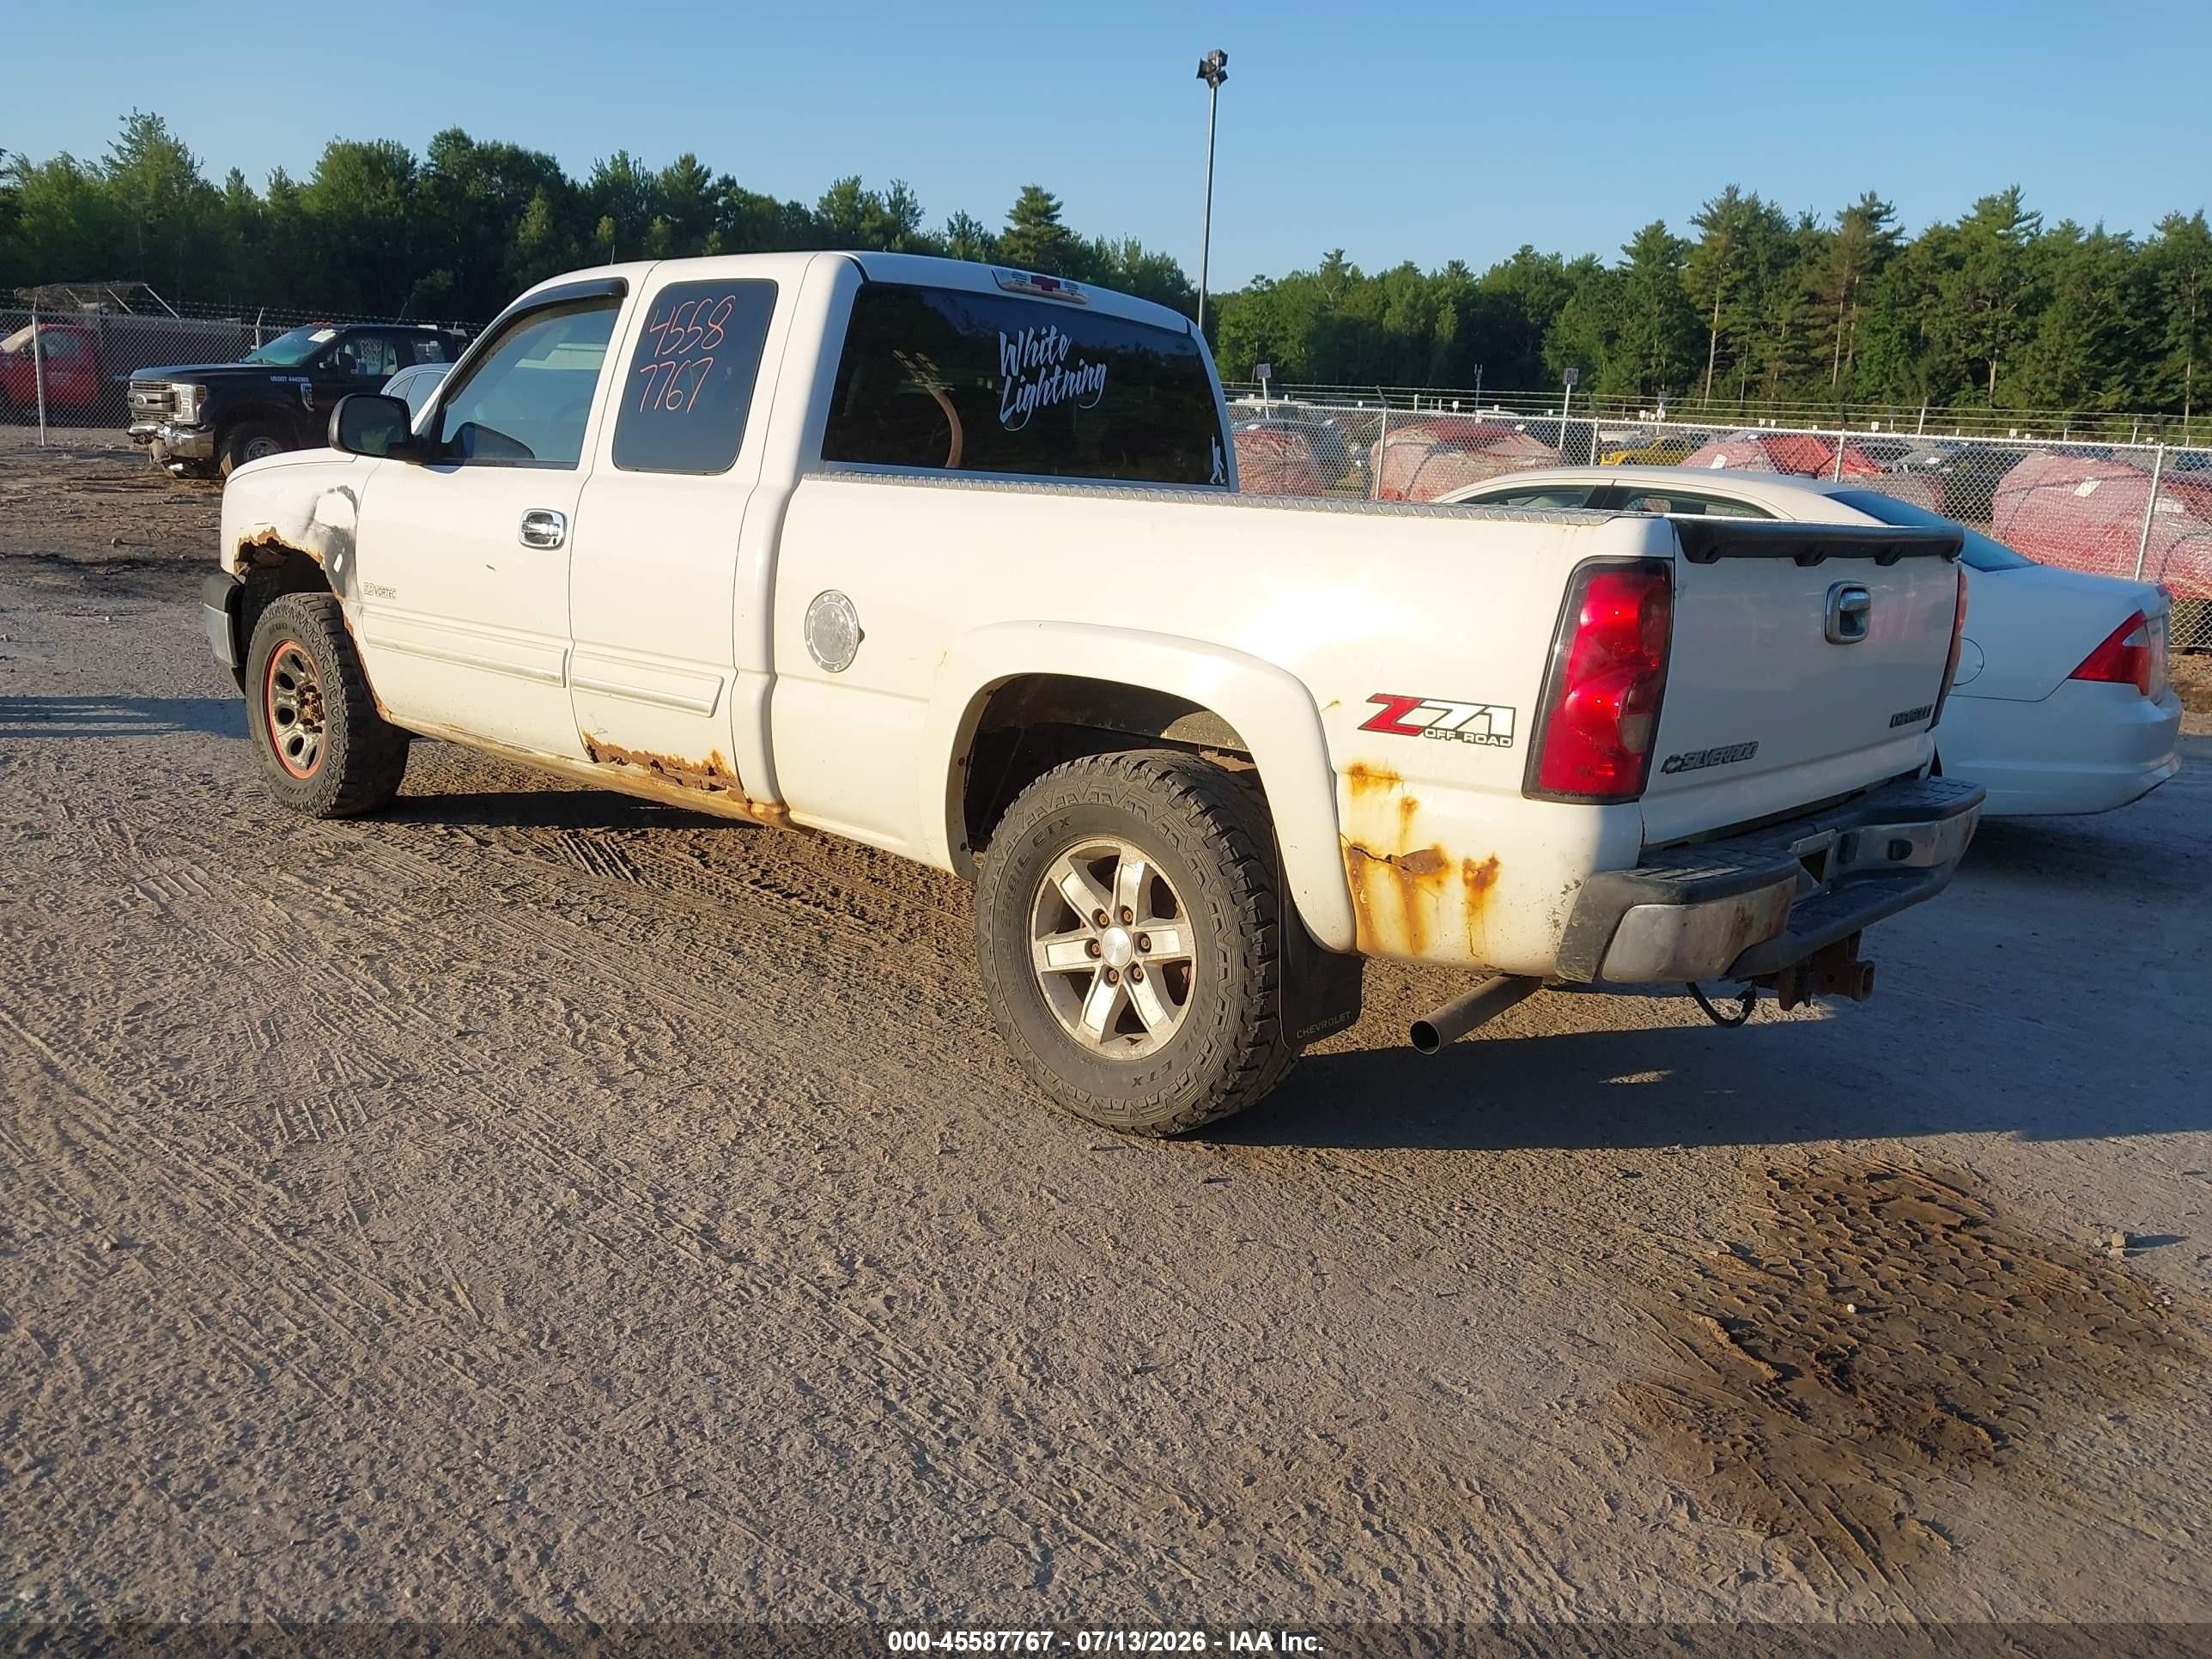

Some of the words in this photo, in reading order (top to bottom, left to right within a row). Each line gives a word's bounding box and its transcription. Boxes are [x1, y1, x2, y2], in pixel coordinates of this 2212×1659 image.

[649, 295, 736, 357] 4558
[1000, 325, 1072, 376] White
[640, 357, 714, 413] 7767
[1000, 358, 1107, 431] Lightning
[1358, 693, 1516, 737] Z71
[1424, 728, 1457, 741] OFF
[1462, 733, 1514, 748] ROAD
[1678, 741, 1759, 772] SILVERADO
[1296, 1011, 1352, 1039] CHEVROLET
